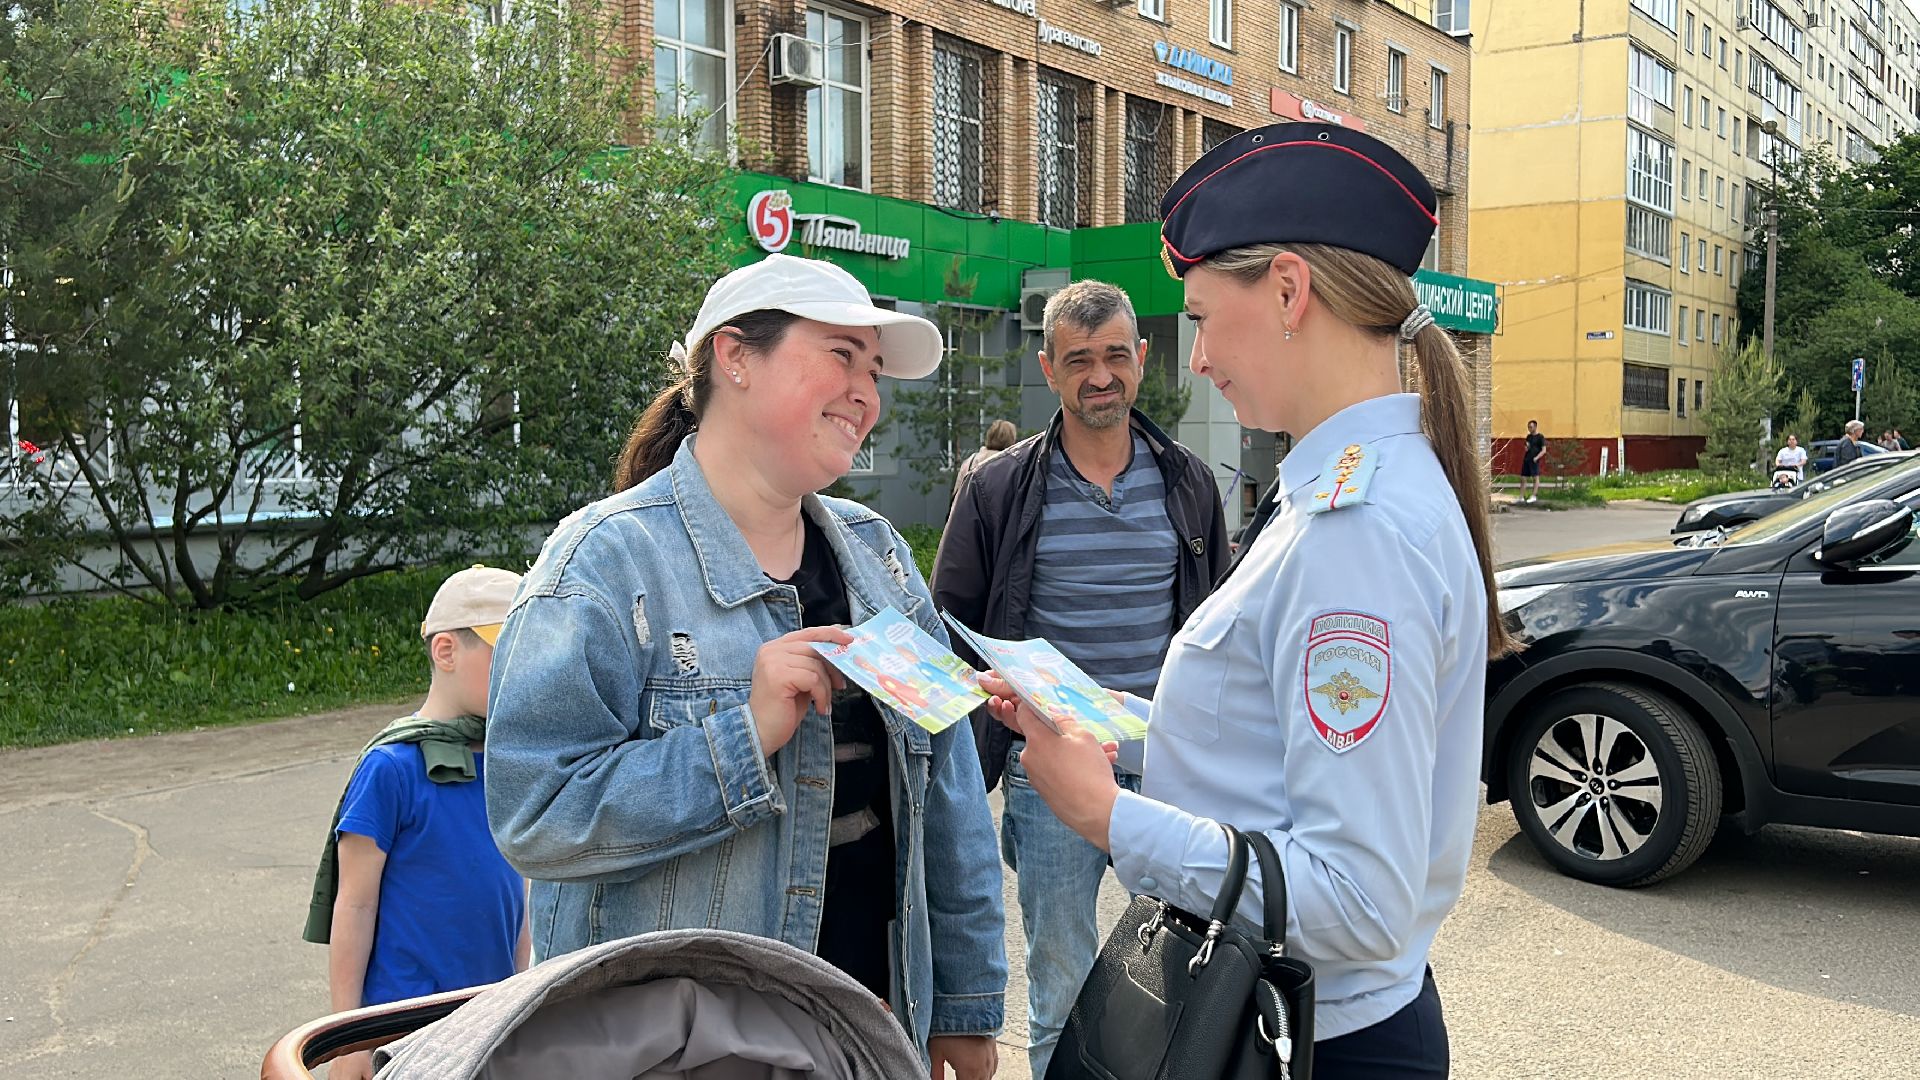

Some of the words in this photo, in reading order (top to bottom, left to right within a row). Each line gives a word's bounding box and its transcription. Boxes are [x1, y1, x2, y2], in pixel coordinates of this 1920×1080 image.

[1038, 18, 1101, 56] Турагентство
[1465, 290, 1493, 323] ЦЕНТР
[1735, 590, 1769, 598] AWD
[1313, 616, 1384, 639] ПОЛИЦИЯ
[1314, 646, 1381, 672] РОССИЯ
[1326, 729, 1355, 748] МВД
